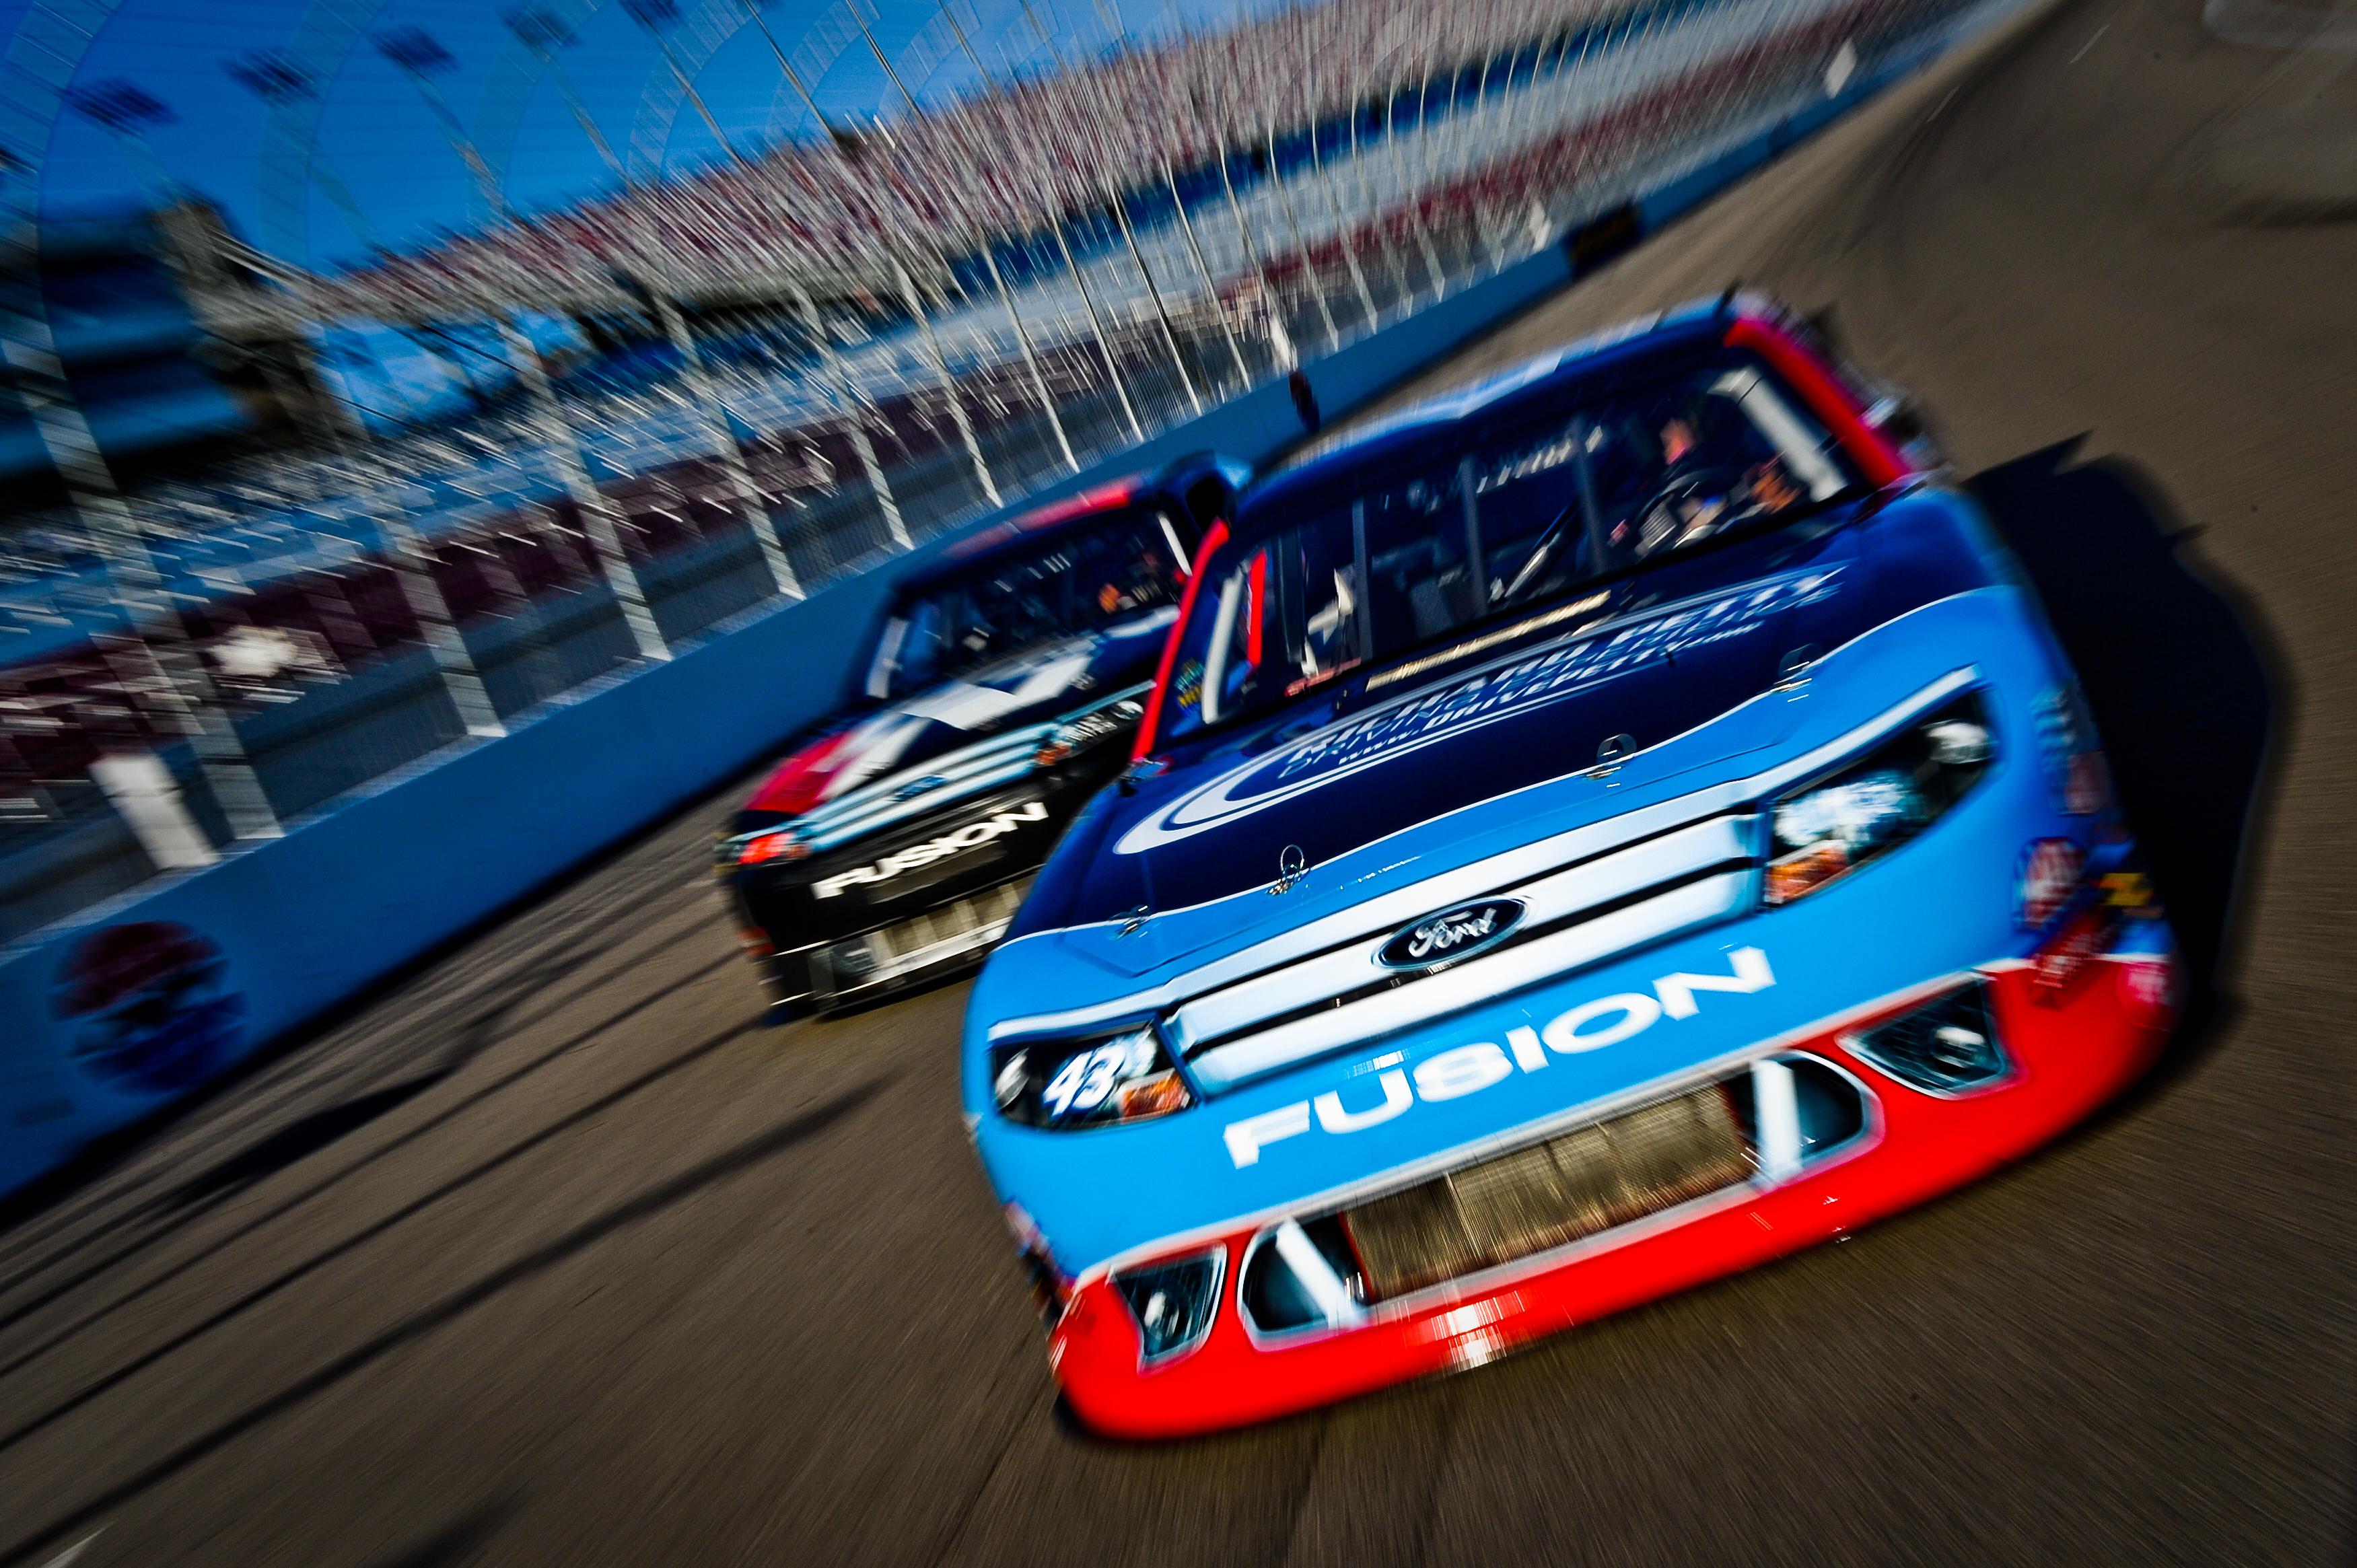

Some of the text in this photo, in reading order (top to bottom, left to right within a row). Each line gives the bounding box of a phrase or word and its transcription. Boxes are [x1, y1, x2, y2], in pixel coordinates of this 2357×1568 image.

[1278, 581, 1845, 779] DRIVING EXPERIENCE
[1286, 640, 1595, 764] RICHARD
[1608, 565, 1850, 648] PETTY
[810, 802, 1049, 899] FUSION
[1408, 908, 1497, 958] Ford
[1042, 1043, 1129, 1117] 43
[1223, 946, 1777, 1169] FUSION
